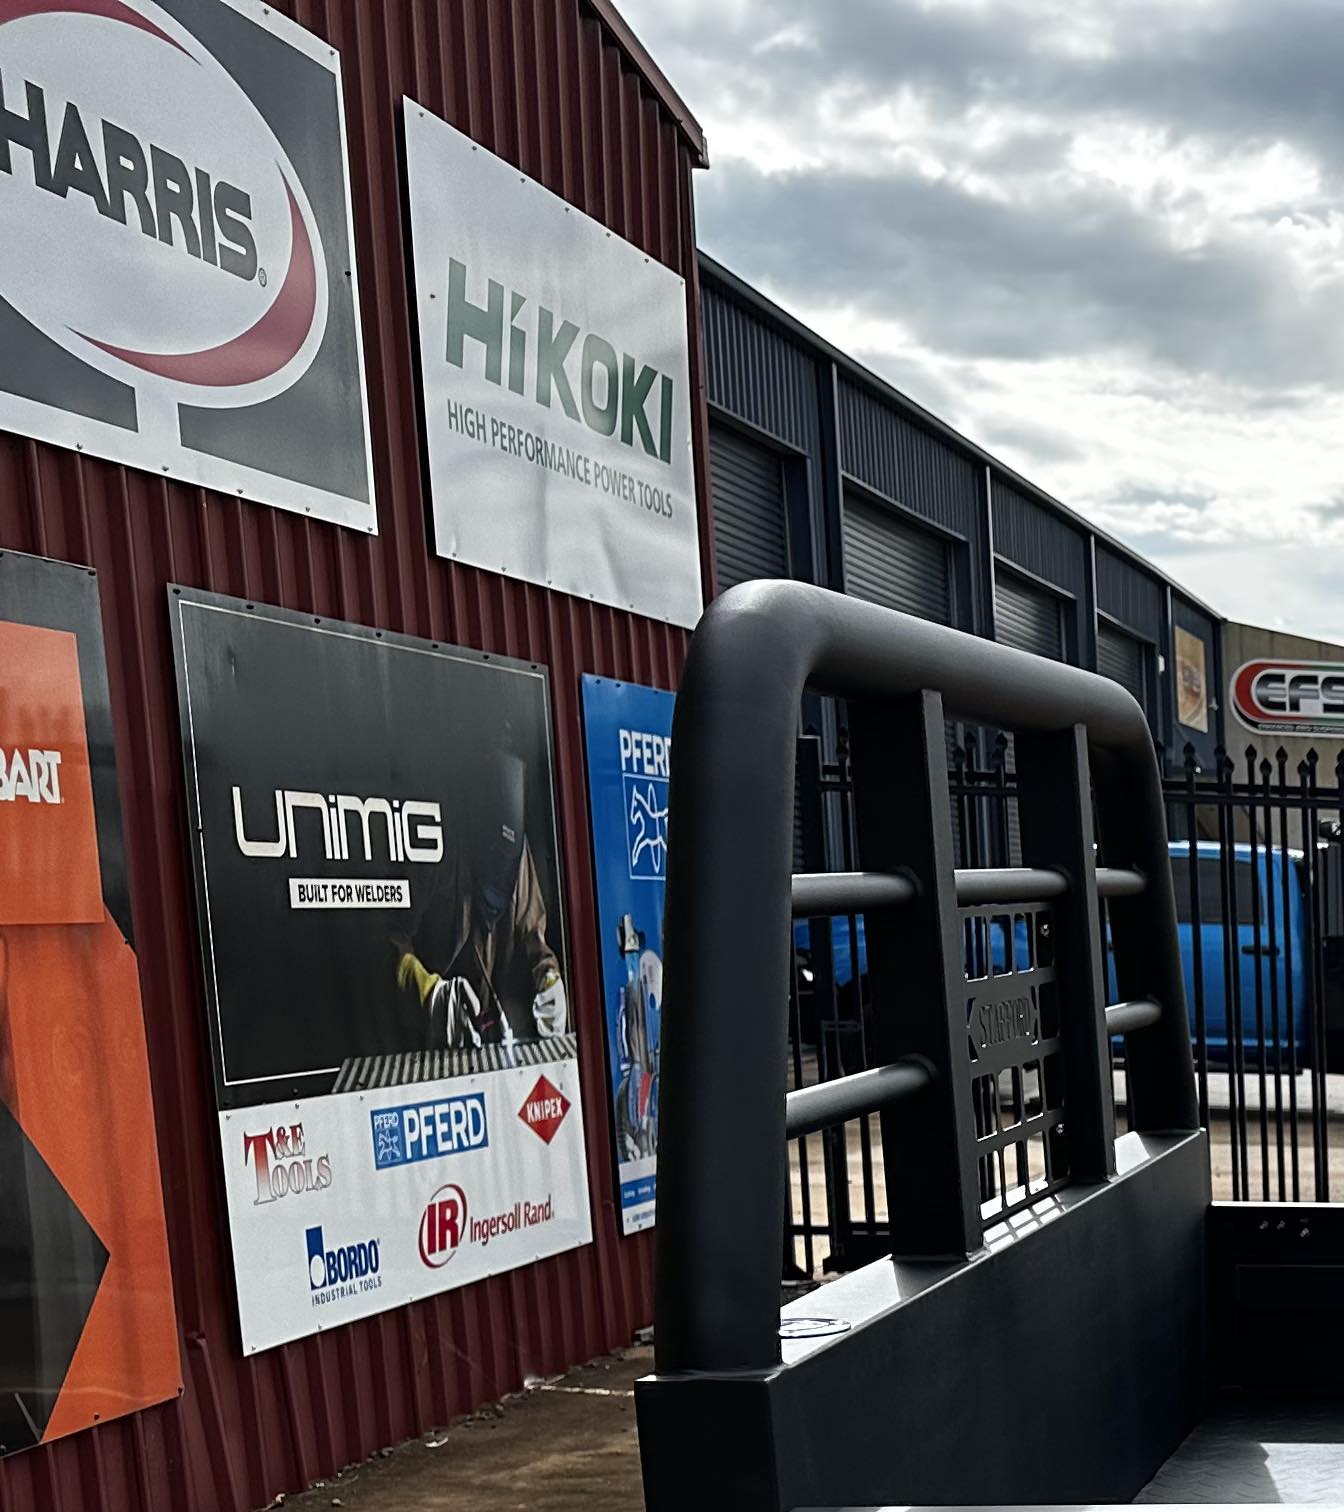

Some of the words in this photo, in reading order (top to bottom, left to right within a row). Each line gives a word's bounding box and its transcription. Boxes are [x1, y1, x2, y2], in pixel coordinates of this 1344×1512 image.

[0, 68, 258, 281] HARRIS
[448, 398, 487, 443] HIGH
[491, 417, 591, 485] PERFORMANCE
[594, 461, 636, 505] POWER
[637, 480, 673, 519] TOOLS
[298, 884, 328, 903] BUILT
[331, 885, 352, 903] FOR
[355, 885, 403, 903] WELDERS
[373, 1112, 399, 1130] PFERD
[403, 1098, 485, 1159] PFERD
[526, 1097, 563, 1123] KNIPEX
[426, 1199, 459, 1256] IR
[470, 1212, 521, 1247] Ingersoll
[523, 1194, 552, 1228] Rand
[326, 1238, 380, 1287] BORDO
[311, 1284, 357, 1307] INDUSTRIAL
[359, 1275, 382, 1292] TOOLS
